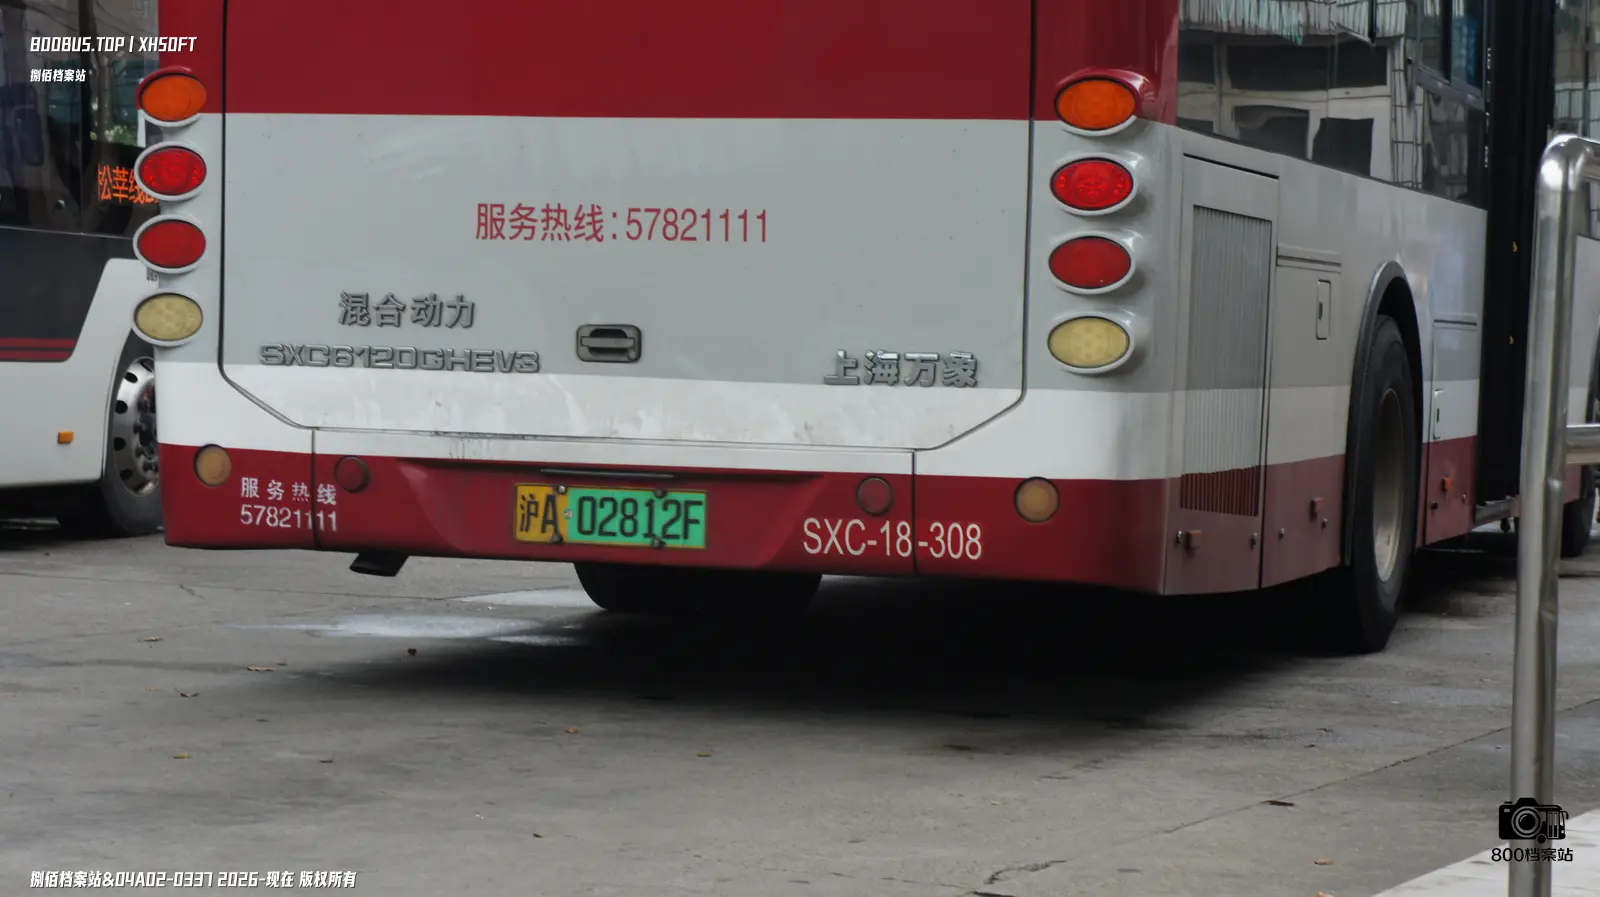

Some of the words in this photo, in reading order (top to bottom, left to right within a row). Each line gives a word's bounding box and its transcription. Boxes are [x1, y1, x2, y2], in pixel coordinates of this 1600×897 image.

[337, 291, 477, 330] 混合动力
[259, 342, 541, 375] SXC6120GHEV3
[824, 349, 979, 388] 上海万象
[240, 476, 337, 506] 服务热线
[240, 503, 338, 533] 57821111
[519, 493, 560, 535] 沪A
[576, 495, 704, 541] 02812F
[802, 517, 983, 560] SXC-18-308
